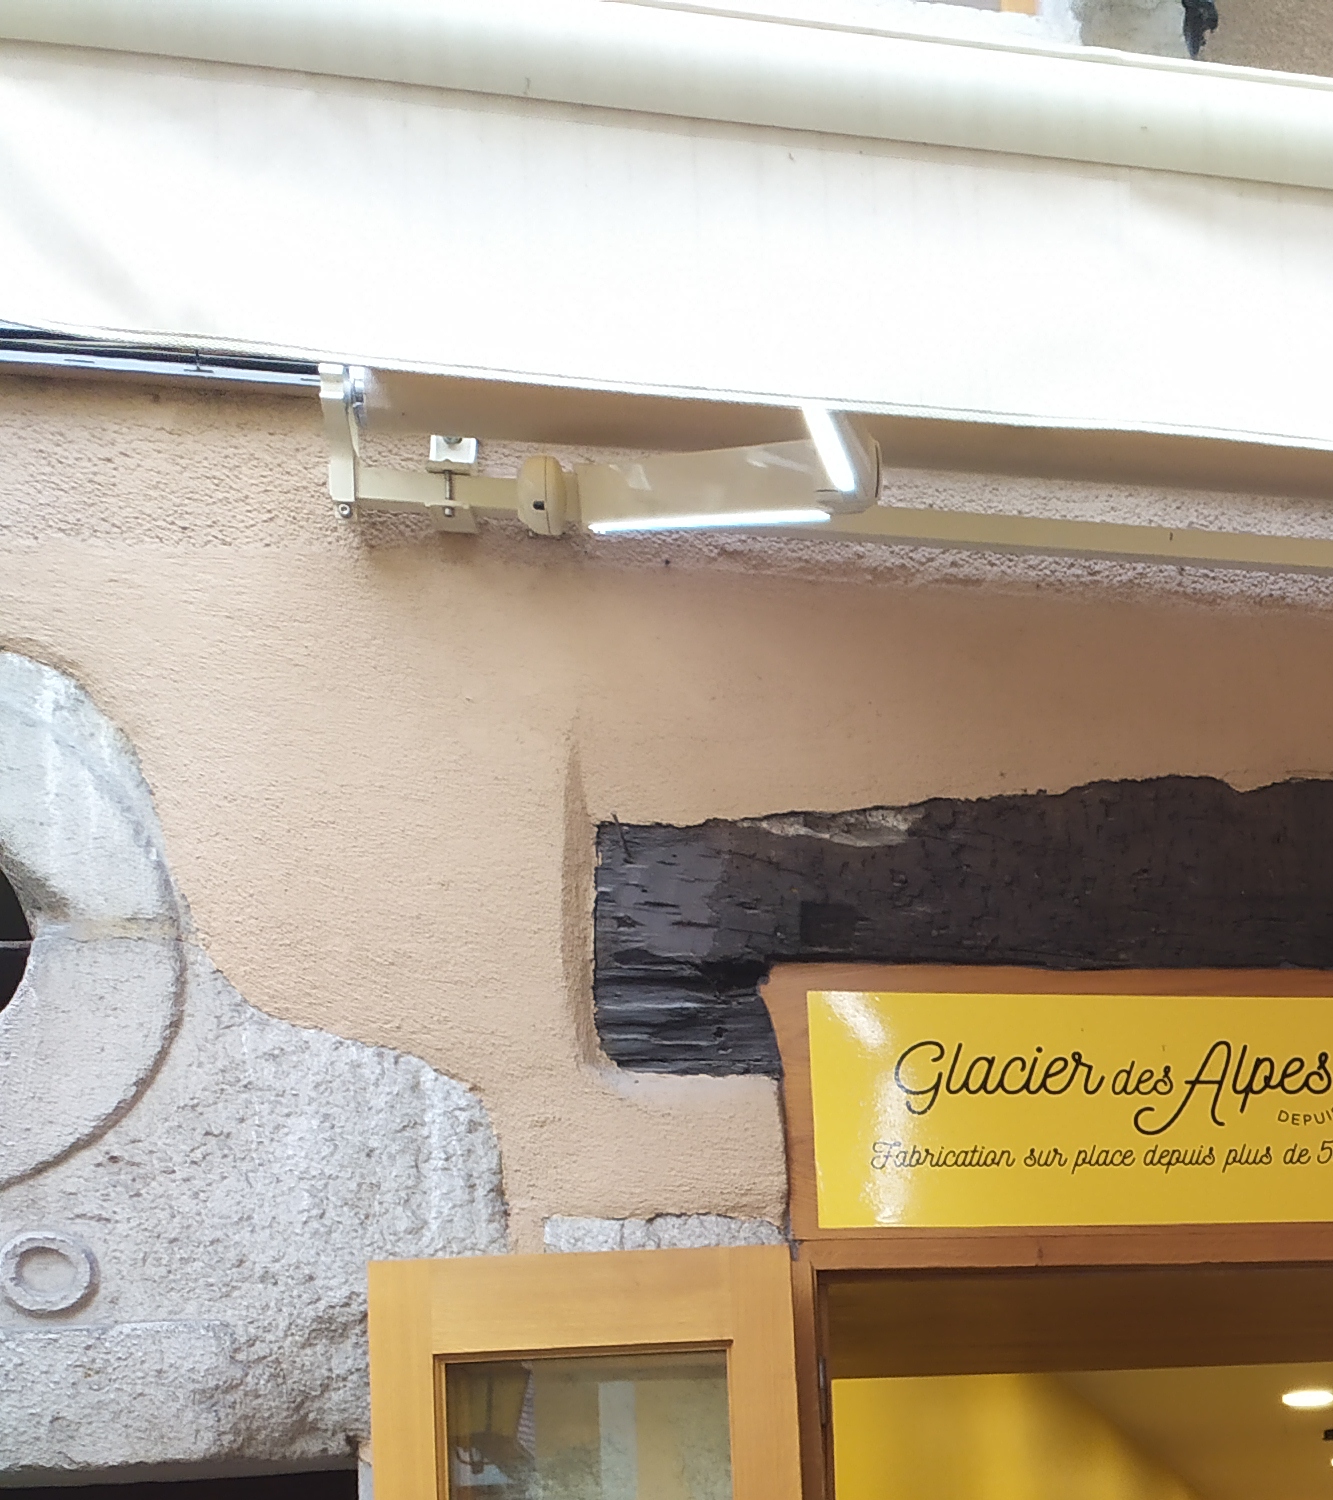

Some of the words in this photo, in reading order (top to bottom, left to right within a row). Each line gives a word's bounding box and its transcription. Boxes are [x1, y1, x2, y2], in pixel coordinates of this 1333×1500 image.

[896, 1041, 1105, 1115] Glacier
[1112, 1061, 1174, 1096] des
[1133, 1041, 1332, 1135] Alpes
[871, 1141, 1016, 1169] Fabrication
[1024, 1148, 1067, 1167] sur
[1072, 1145, 1135, 1174] place
[1144, 1145, 1215, 1173] depuis
[1222, 1144, 1272, 1173] plus
[1283, 1144, 1311, 1164] de
